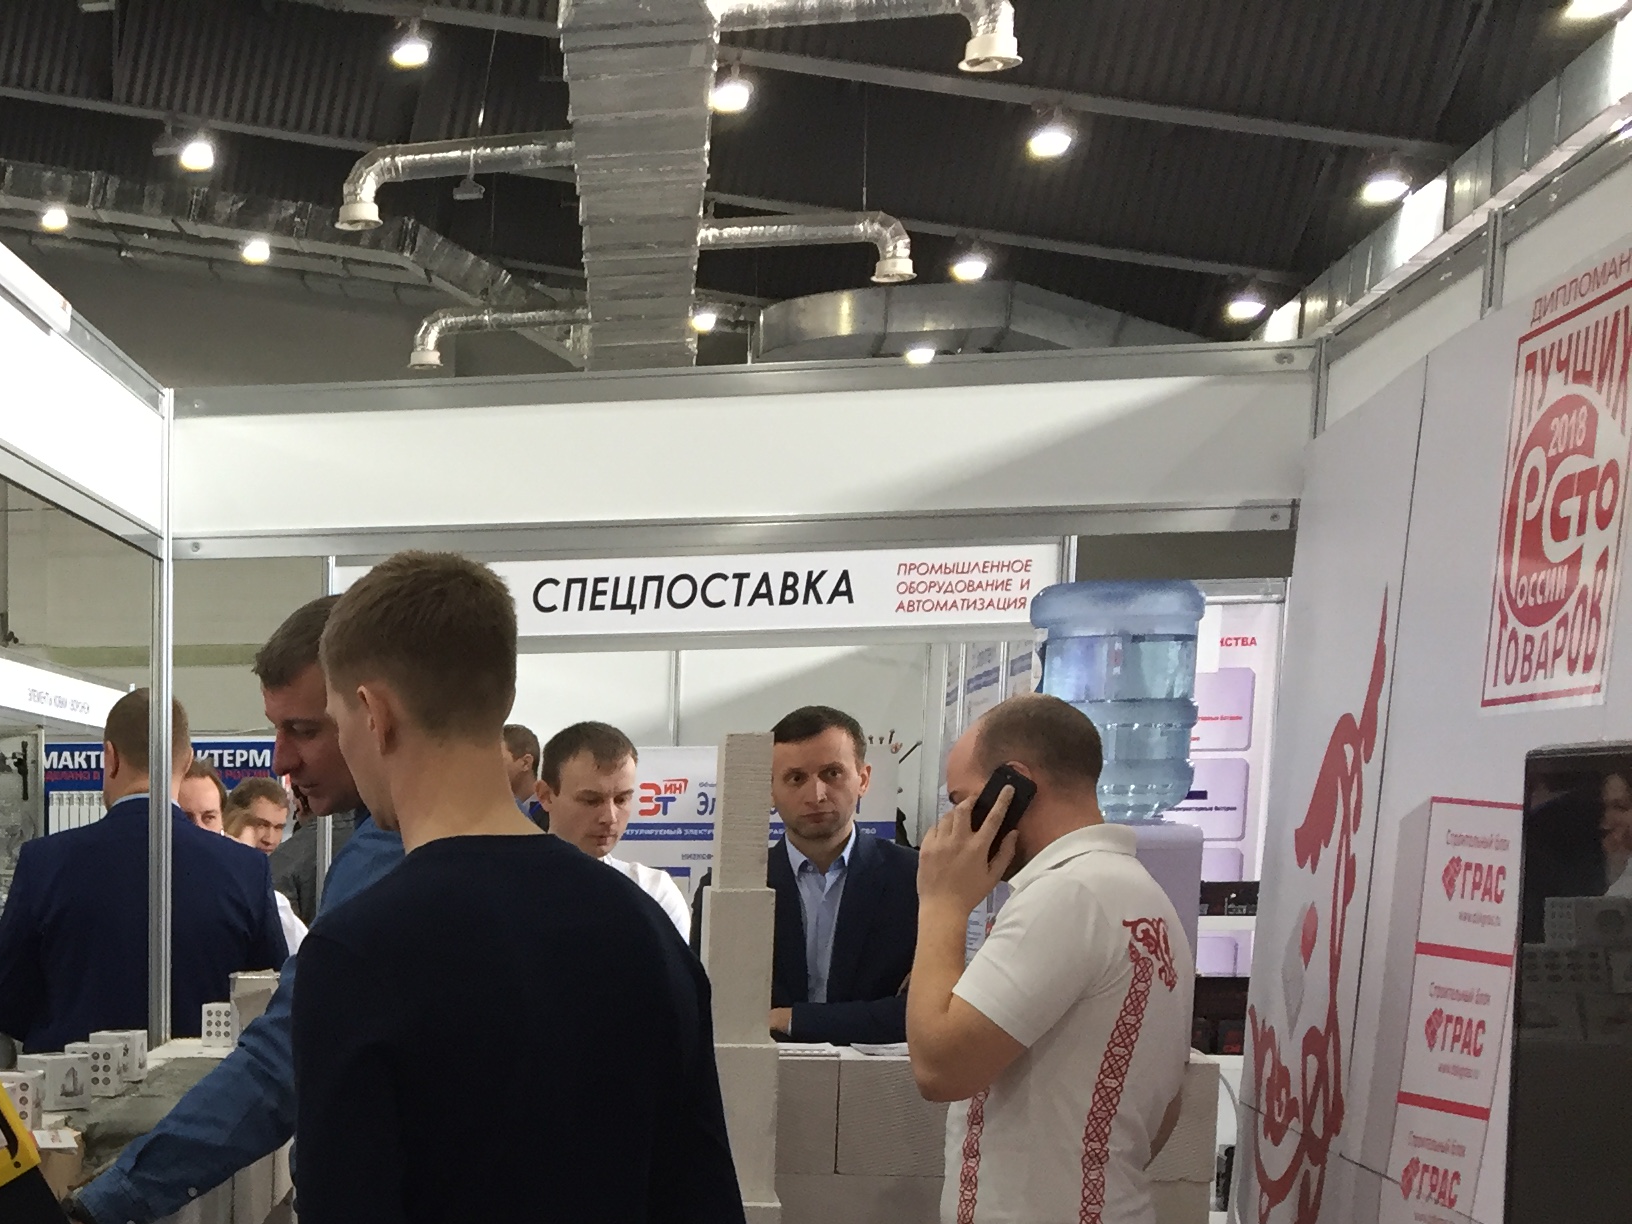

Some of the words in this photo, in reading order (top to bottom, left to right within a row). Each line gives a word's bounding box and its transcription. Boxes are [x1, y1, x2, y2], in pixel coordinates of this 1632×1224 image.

[1547, 405, 1588, 457] 2018
[895, 578, 1014, 595] ОБОРУДОВАНИЕ
[1019, 578, 1031, 591] И
[896, 559, 1033, 577] ПРОМЫШЛЕННОЕ
[532, 568, 855, 615] СПЕЦПОСТАВКА
[894, 596, 1028, 614] АВТОМАТИЗАЦИЯ
[1493, 545, 1609, 687] ТОВАРОВ
[1459, 860, 1507, 905] ГРАС
[1440, 1013, 1486, 1058] ГРАС
[1416, 1162, 1462, 1209] ГРАС
